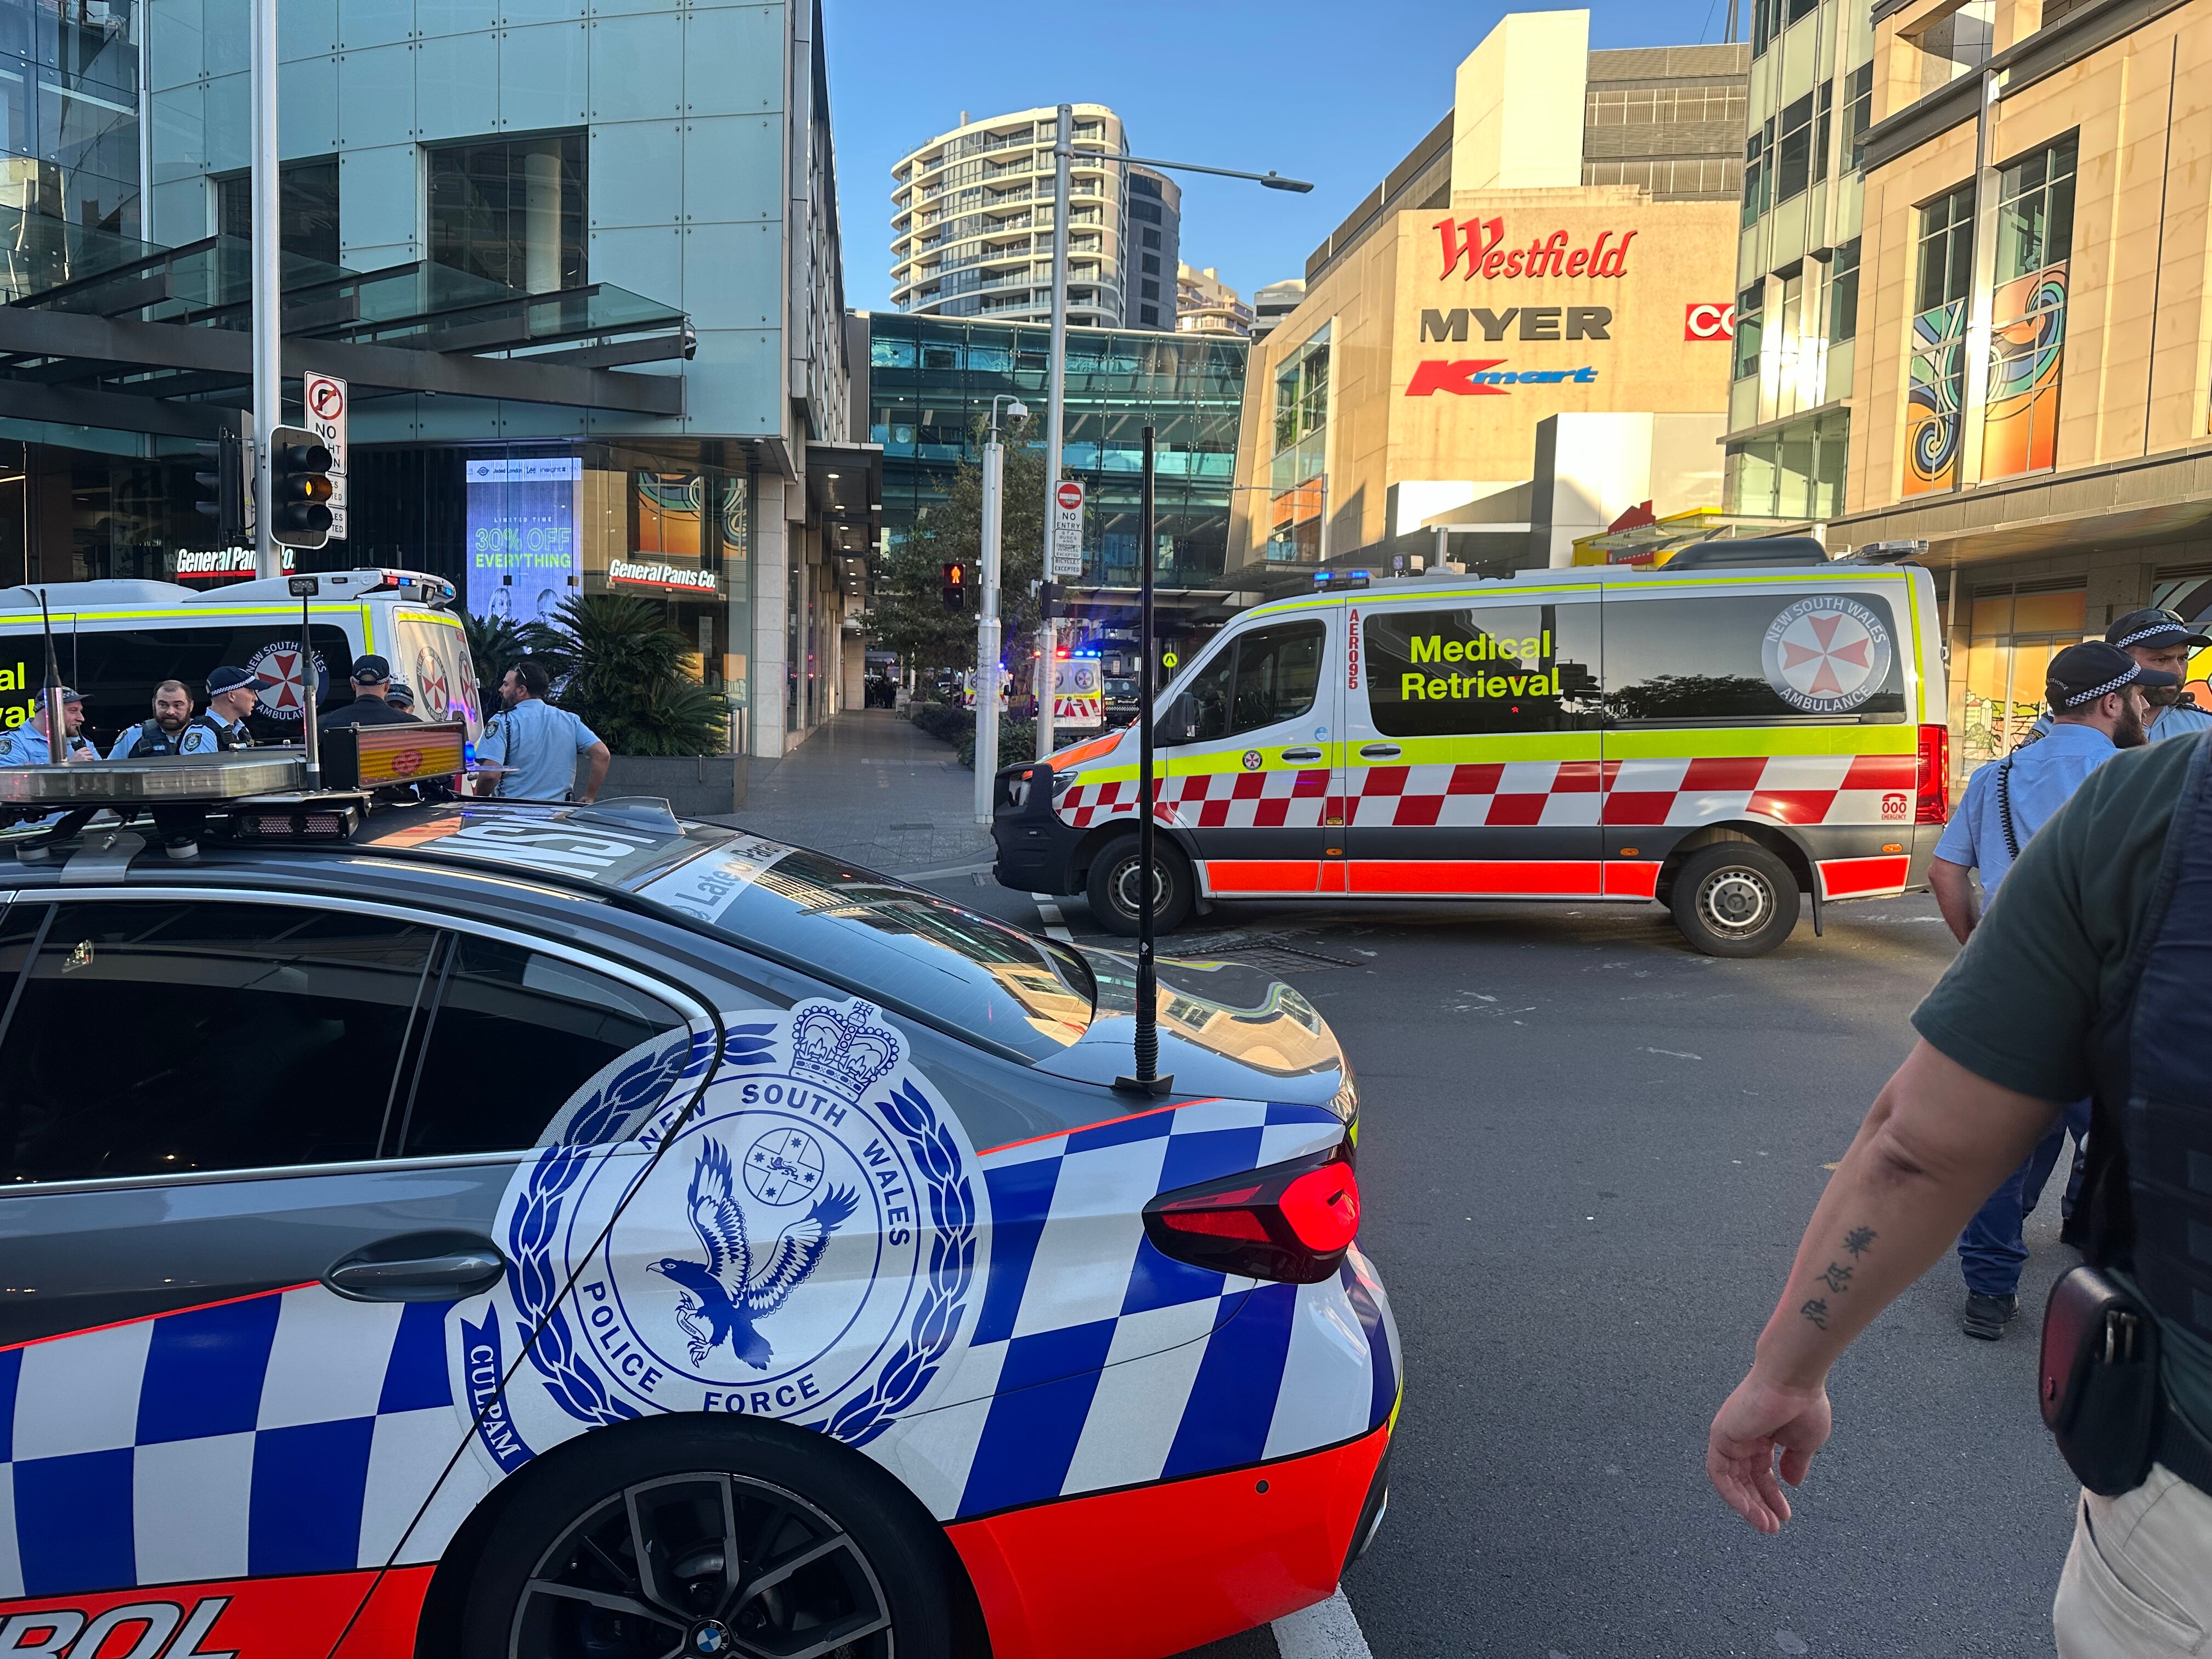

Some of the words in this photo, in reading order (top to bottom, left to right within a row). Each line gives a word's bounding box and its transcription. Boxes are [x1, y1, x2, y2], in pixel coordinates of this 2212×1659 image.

[1432, 216, 1638, 281] Westfield
[1420, 306, 1612, 342] MYER
[1404, 359, 1599, 396] Kmart
[315, 422, 336, 439] NO
[476, 527, 522, 551] 30%
[527, 527, 571, 551] OFF
[177, 546, 233, 573] General
[232, 546, 256, 571] Pan
[476, 553, 571, 568] EVERYTHING
[609, 558, 662, 582] General
[662, 566, 698, 586] Pants
[697, 570, 716, 588] Co.
[1767, 611, 1793, 642] NEW
[1792, 597, 1844, 616] SOUTH
[1847, 602, 1886, 644] WALES
[246, 651, 264, 675] NEW
[263, 641, 298, 655] SOUTH
[301, 649, 327, 673] ALES
[1410, 629, 1550, 664] Medical
[1401, 667, 1559, 701] Retrieval
[1779, 685, 1872, 712] AMBULANCE
[256, 704, 304, 720] AMBULAN
[1882, 802, 1906, 814] 000
[675, 871, 741, 907] Late
[638, 1094, 707, 1152] NEW
[741, 1083, 848, 1128] SOUTH
[862, 1139, 911, 1248] WALES
[680, 1319, 697, 1335] NEMESIS
[582, 1280, 664, 1394] POLICE
[703, 1372, 820, 1414] FORCE
[470, 1344, 521, 1460] CULPAM
[0, 1595, 241, 1659] ROL
[709, 1621, 727, 1651] BMW
